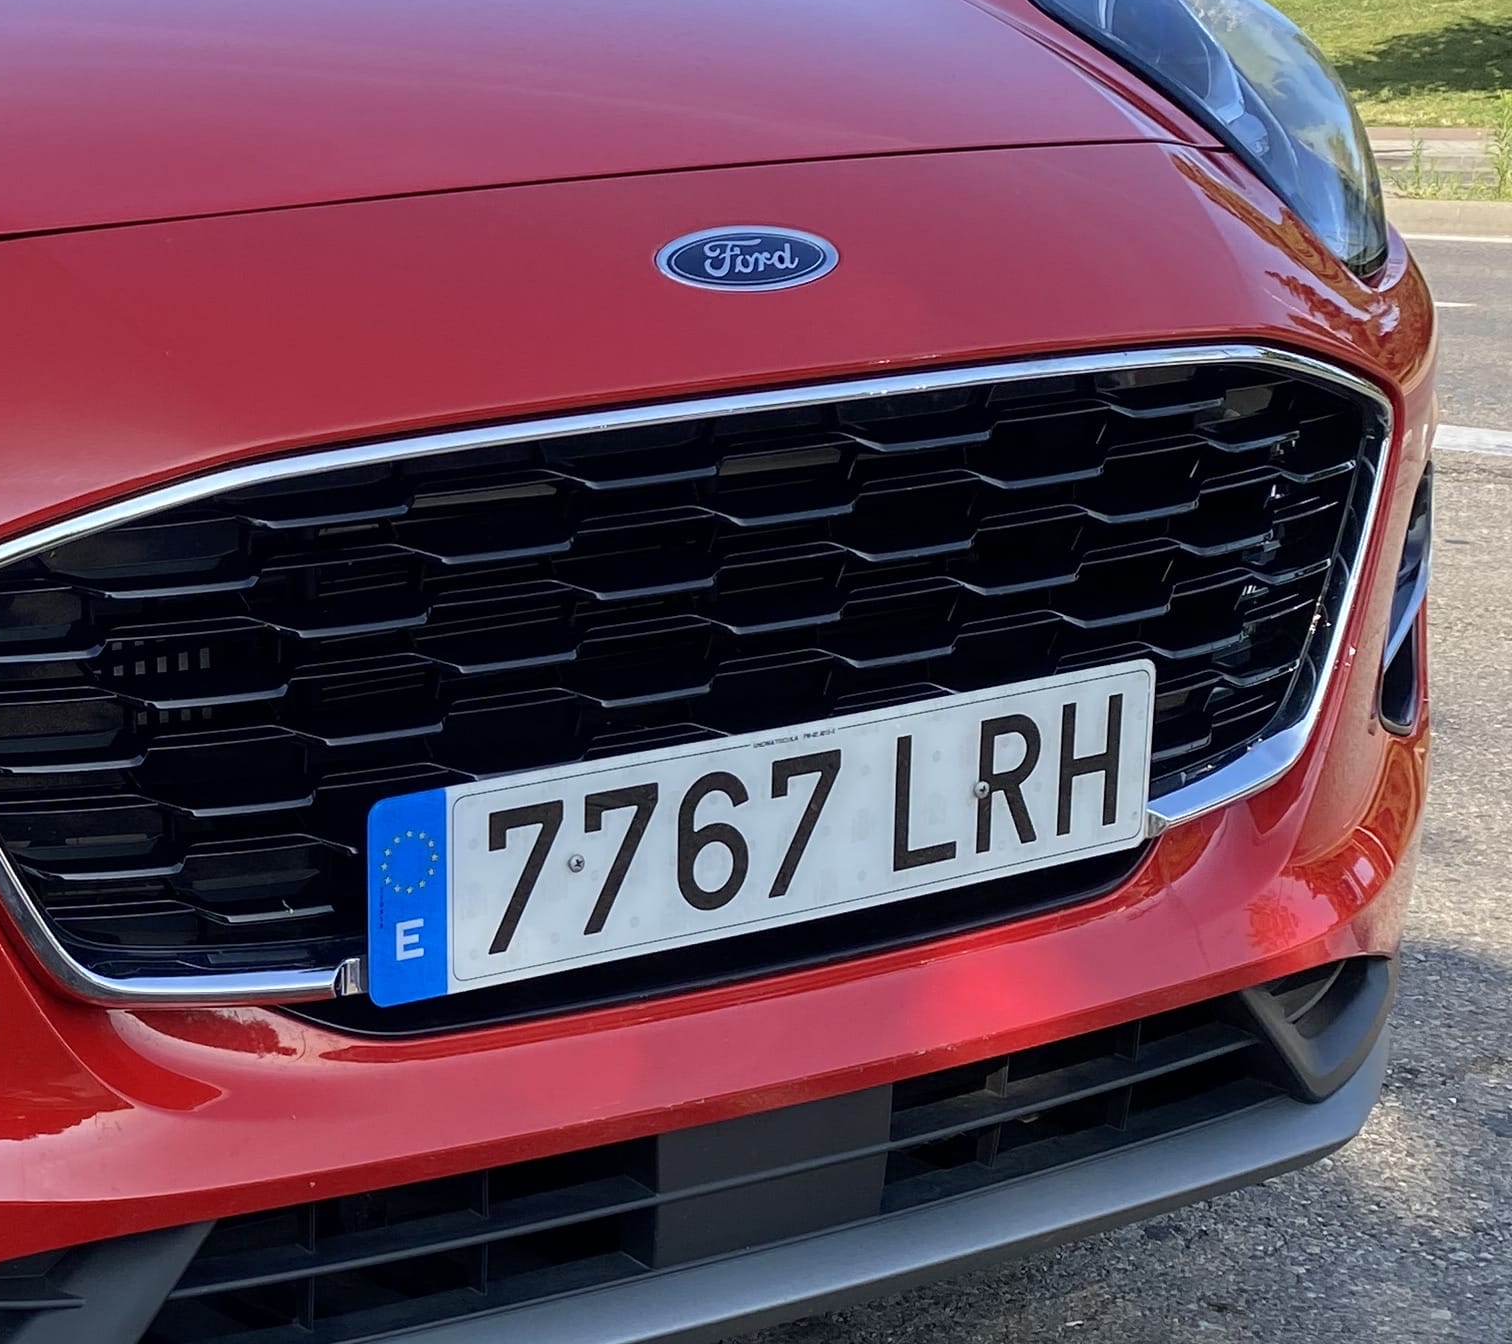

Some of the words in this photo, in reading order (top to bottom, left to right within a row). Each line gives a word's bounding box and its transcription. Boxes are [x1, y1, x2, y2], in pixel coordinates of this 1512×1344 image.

[703, 238, 799, 277] Ford
[488, 750, 841, 955] 7767
[893, 693, 1124, 873] LRH
[395, 918, 425, 961] E
